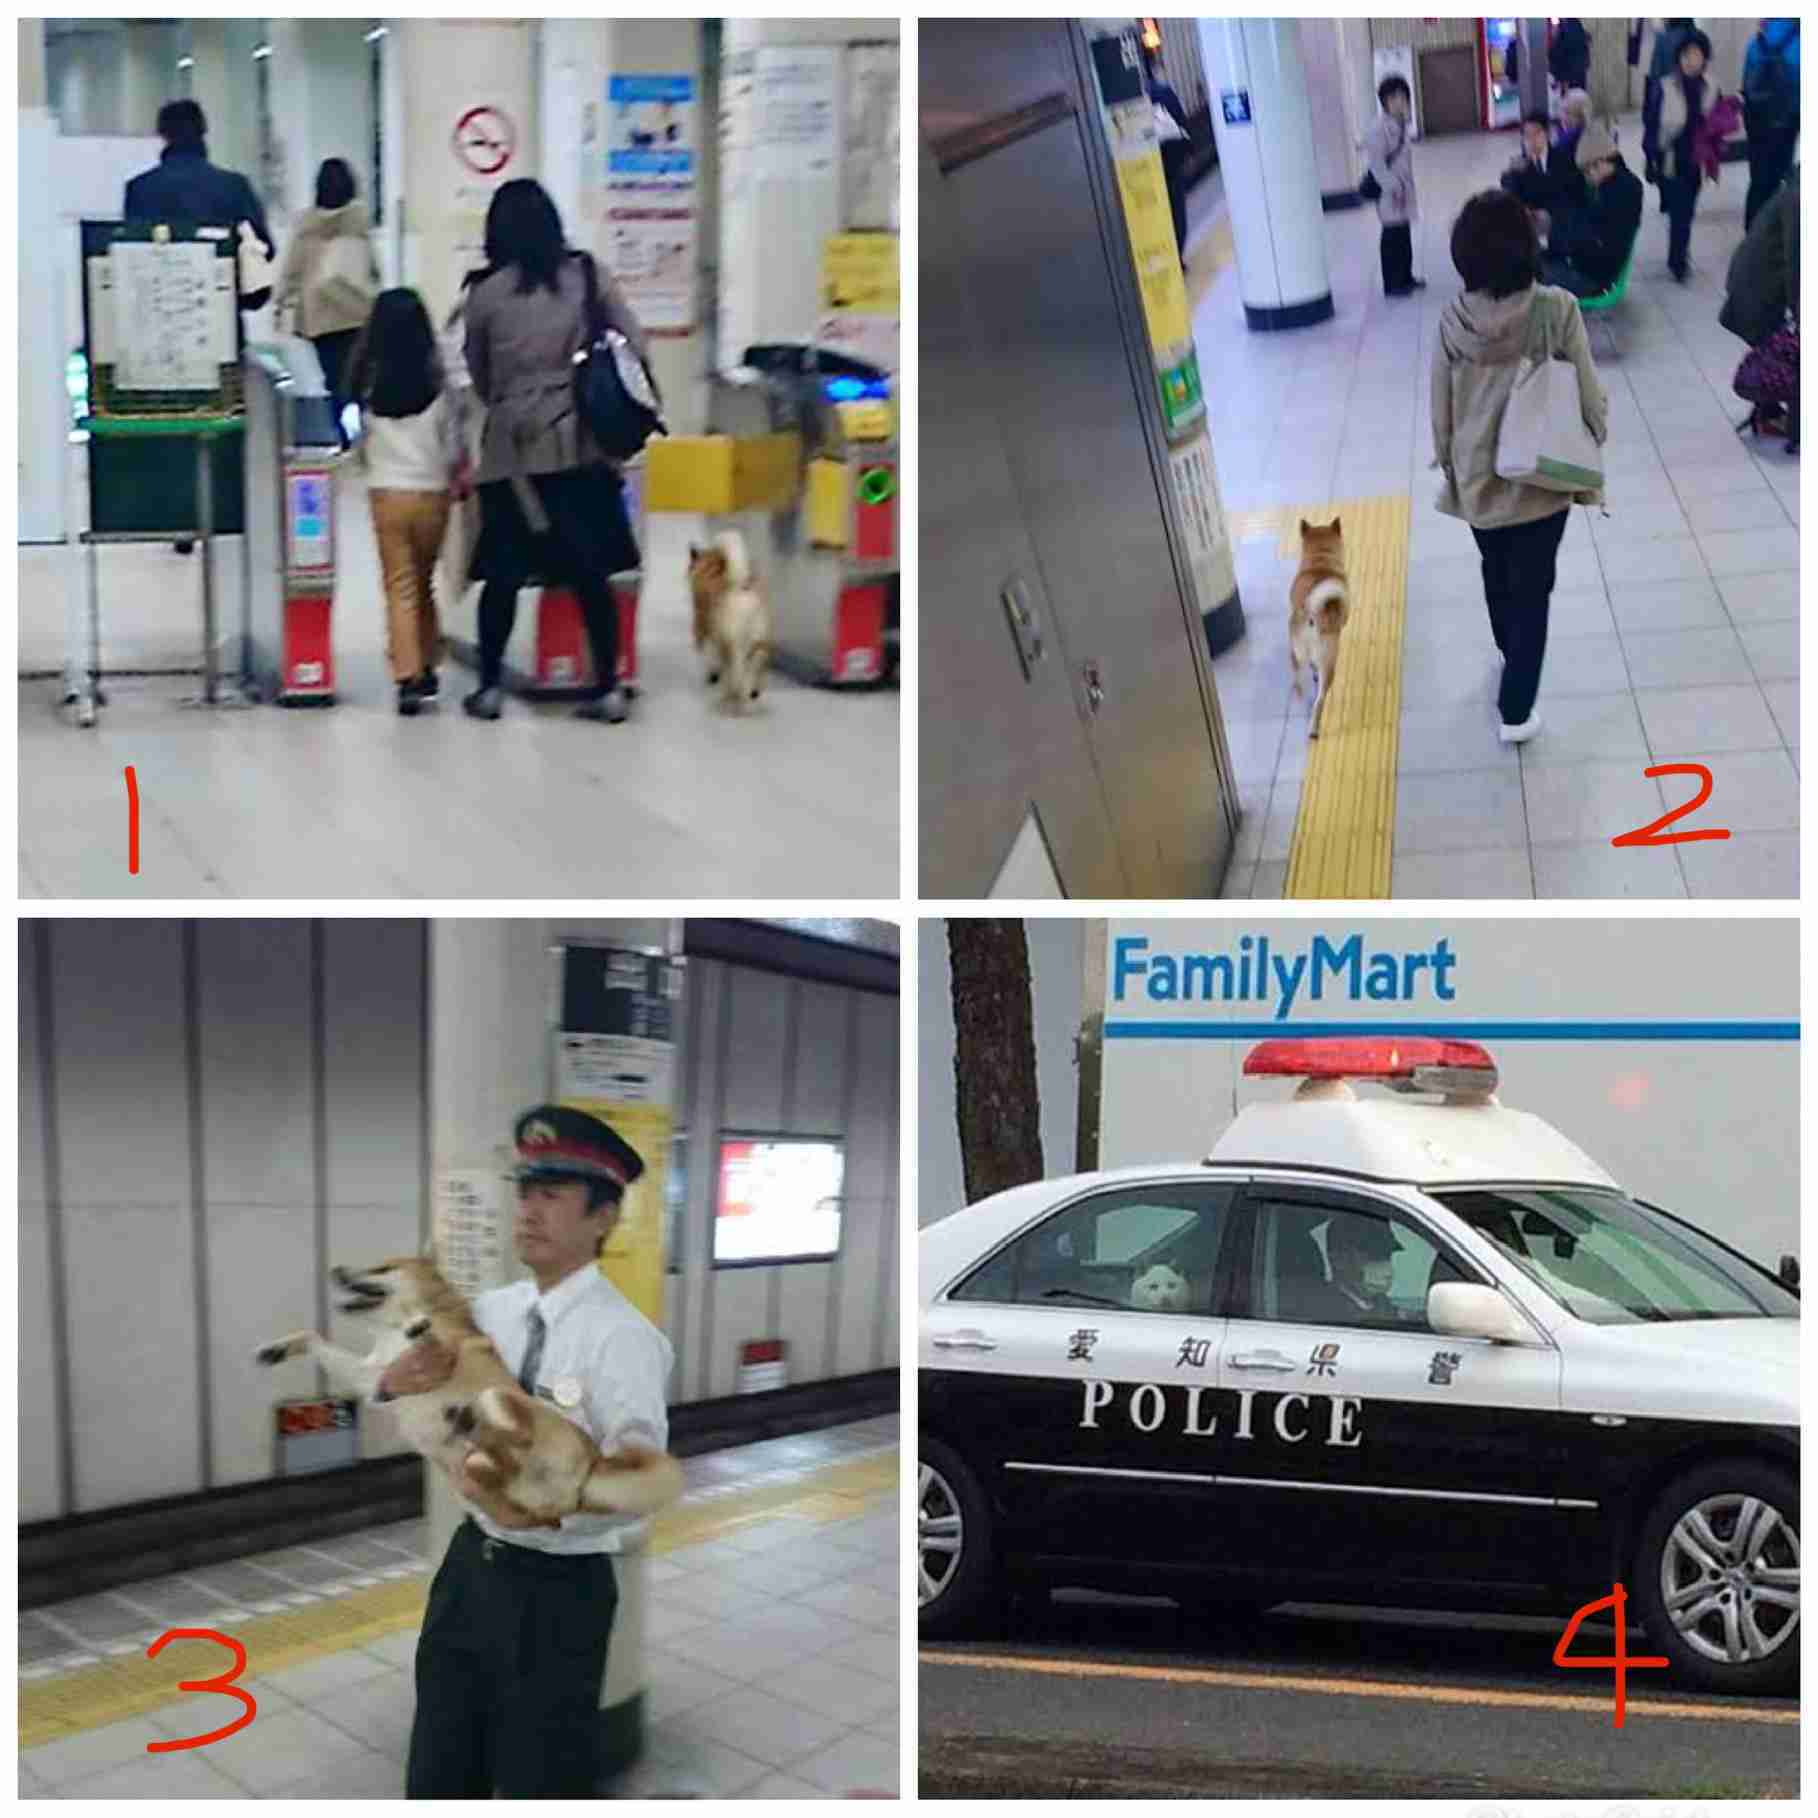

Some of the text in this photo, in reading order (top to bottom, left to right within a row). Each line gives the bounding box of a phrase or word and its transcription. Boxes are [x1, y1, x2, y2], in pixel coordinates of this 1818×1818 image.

[1113, 934, 1456, 1021] FamilyMart
[1067, 1328, 1461, 1386] 愛知県警
[1079, 1379, 1363, 1447] POLICE
